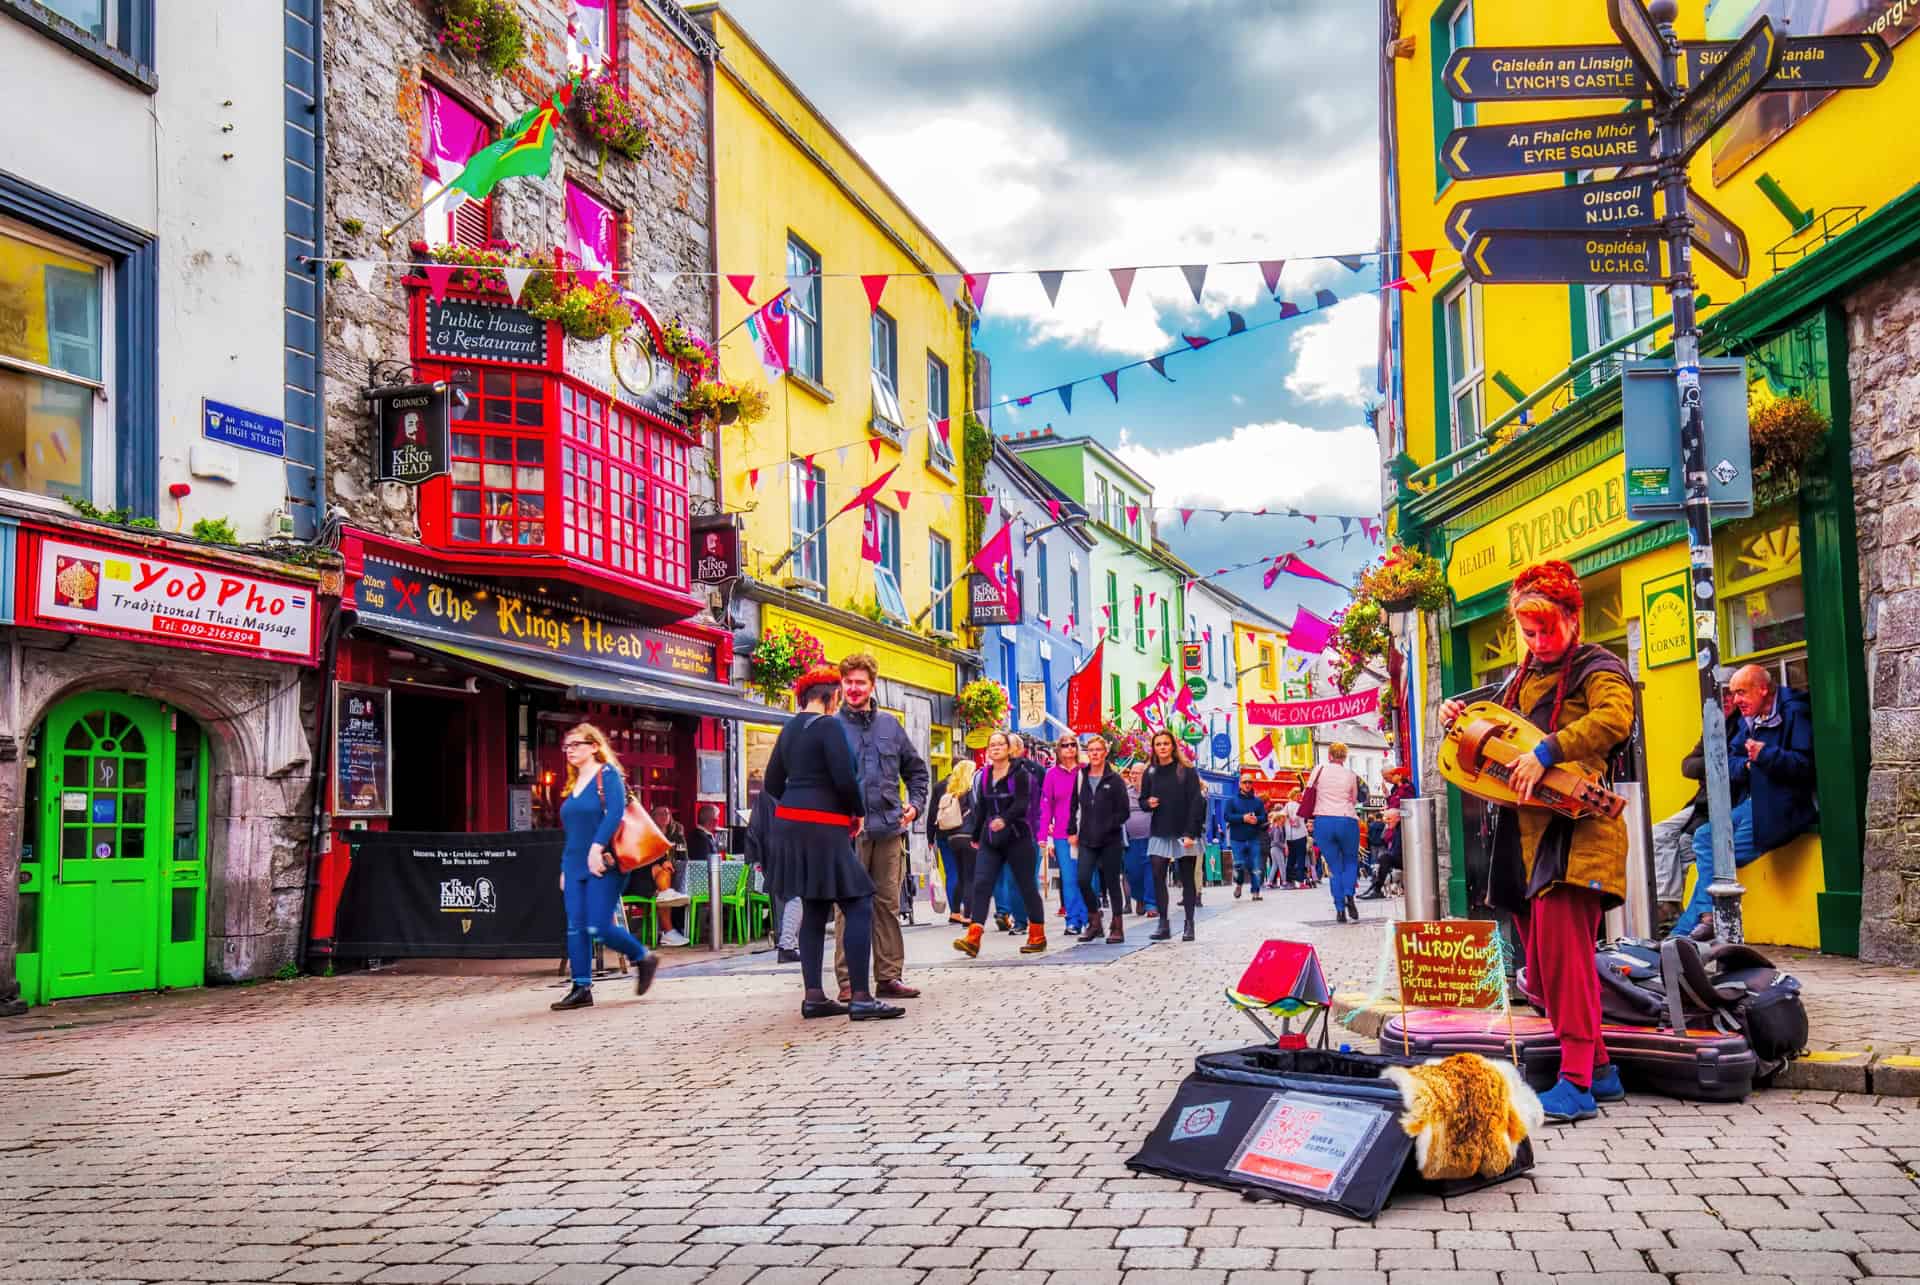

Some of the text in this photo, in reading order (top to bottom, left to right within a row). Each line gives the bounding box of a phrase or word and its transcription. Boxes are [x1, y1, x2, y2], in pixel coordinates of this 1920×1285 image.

[1492, 55, 1633, 72] Caisleán an Linsigh
[1505, 74, 1634, 90] LYNCH'S CASTLE
[1507, 123, 1636, 147] An Fhaiche Mhór
[1524, 141, 1638, 163] EYRE SQUARE
[1585, 204, 1644, 224] N.U.I.G.
[1585, 241, 1646, 257] Ospidéal
[1589, 260, 1648, 273] U.C.H.G.
[440, 309, 534, 335] Public House
[436, 329, 537, 353] & Restaurant
[225, 424, 281, 449] HIGH STREET
[391, 462, 430, 477] HEAD
[1459, 545, 1496, 577] HEALTH
[1506, 474, 1626, 568] EVERGRE
[133, 562, 287, 617] Yod Pho
[362, 574, 387, 590] Since
[365, 589, 385, 609] 1649
[112, 593, 297, 638] Traditional Thai Massage
[427, 582, 642, 660] The Kings Head
[974, 605, 1008, 617] BISTR
[1651, 634, 1688, 654] CORNER
[1290, 707, 1310, 722] ON
[1311, 696, 1371, 721] GALWAY
[440, 895, 473, 907] HEAD
[1423, 922, 1441, 935] It's
[1416, 964, 1432, 977] you
[1433, 963, 1455, 974] want
[1457, 965, 1466, 976] to
[1428, 990, 1441, 1001] and
[1443, 991, 1459, 1002] TIP
